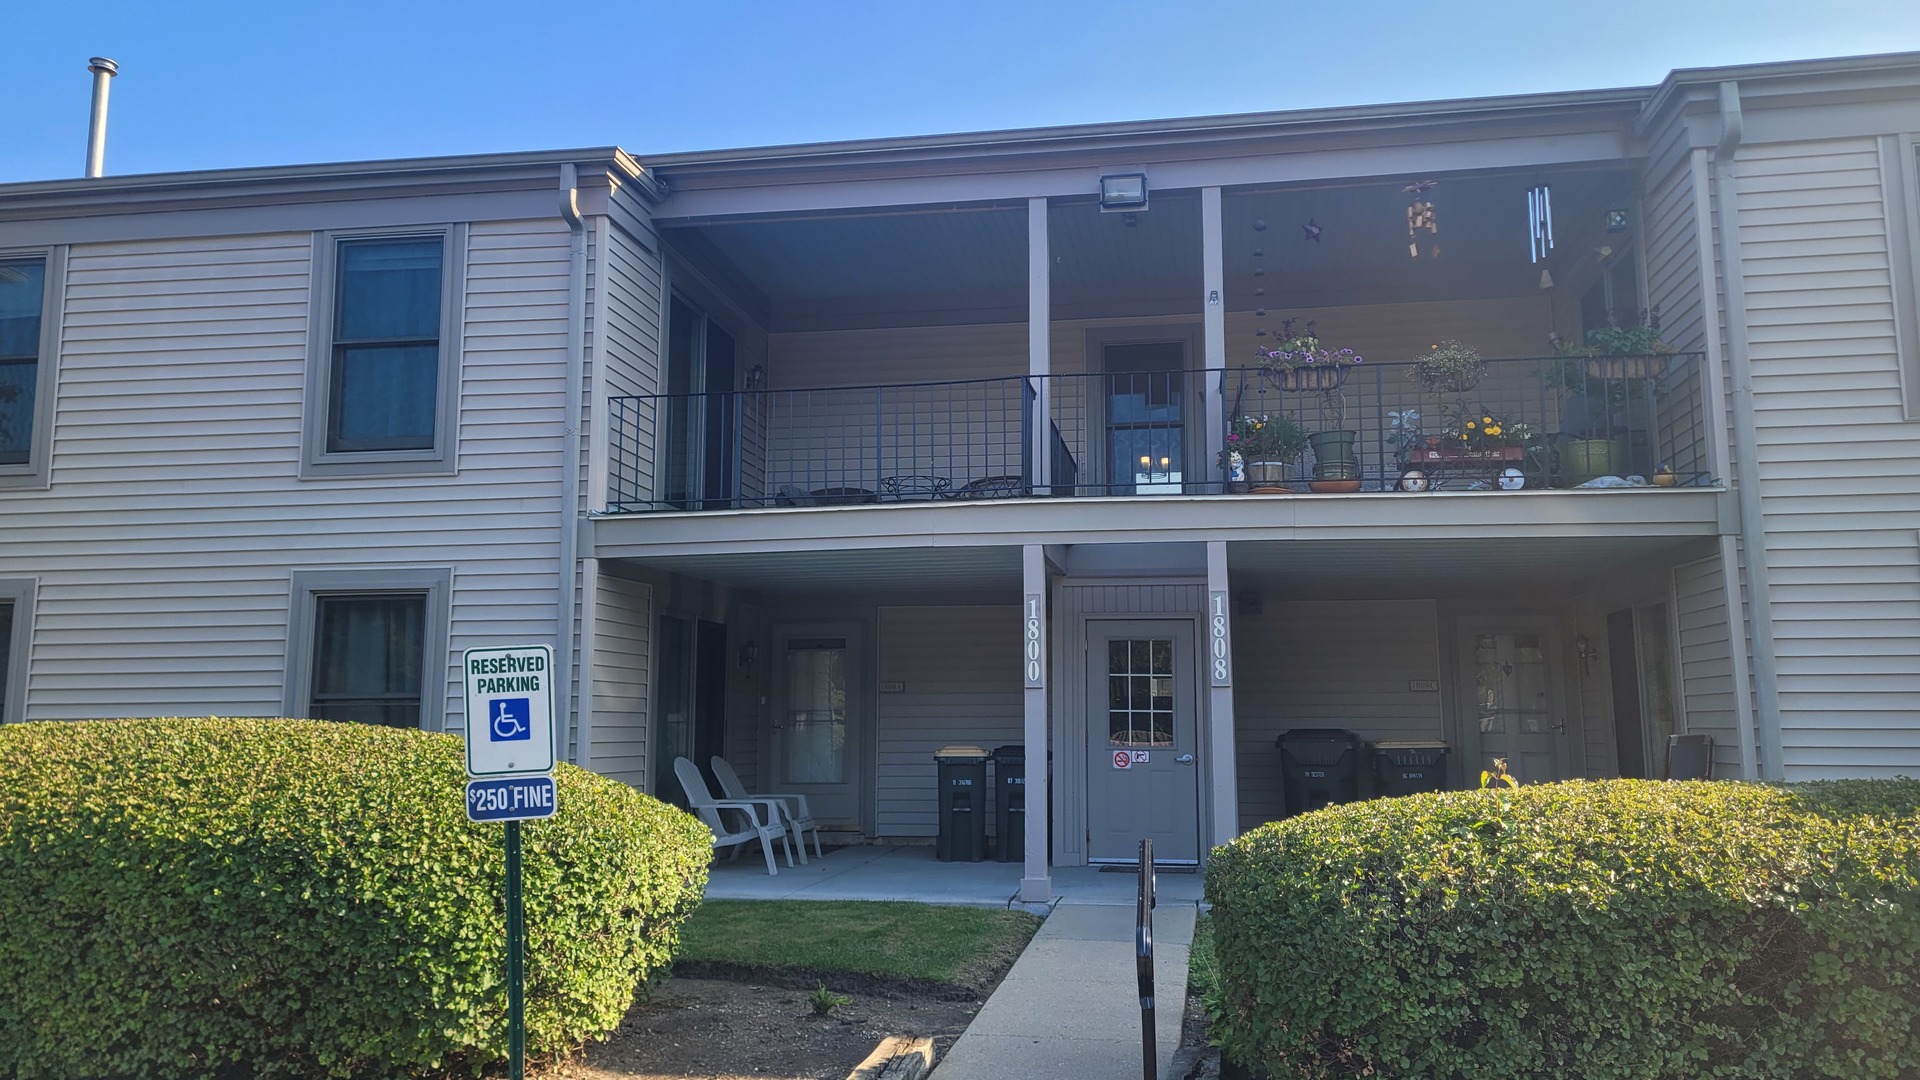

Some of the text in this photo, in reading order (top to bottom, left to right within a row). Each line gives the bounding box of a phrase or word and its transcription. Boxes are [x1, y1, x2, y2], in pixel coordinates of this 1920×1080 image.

[1027, 599, 1040, 682] 1800
[1213, 595, 1227, 680] 1808
[470, 656, 545, 675] RESERVED
[477, 675, 540, 694] PARKING
[469, 785, 552, 812] $250 FINE
